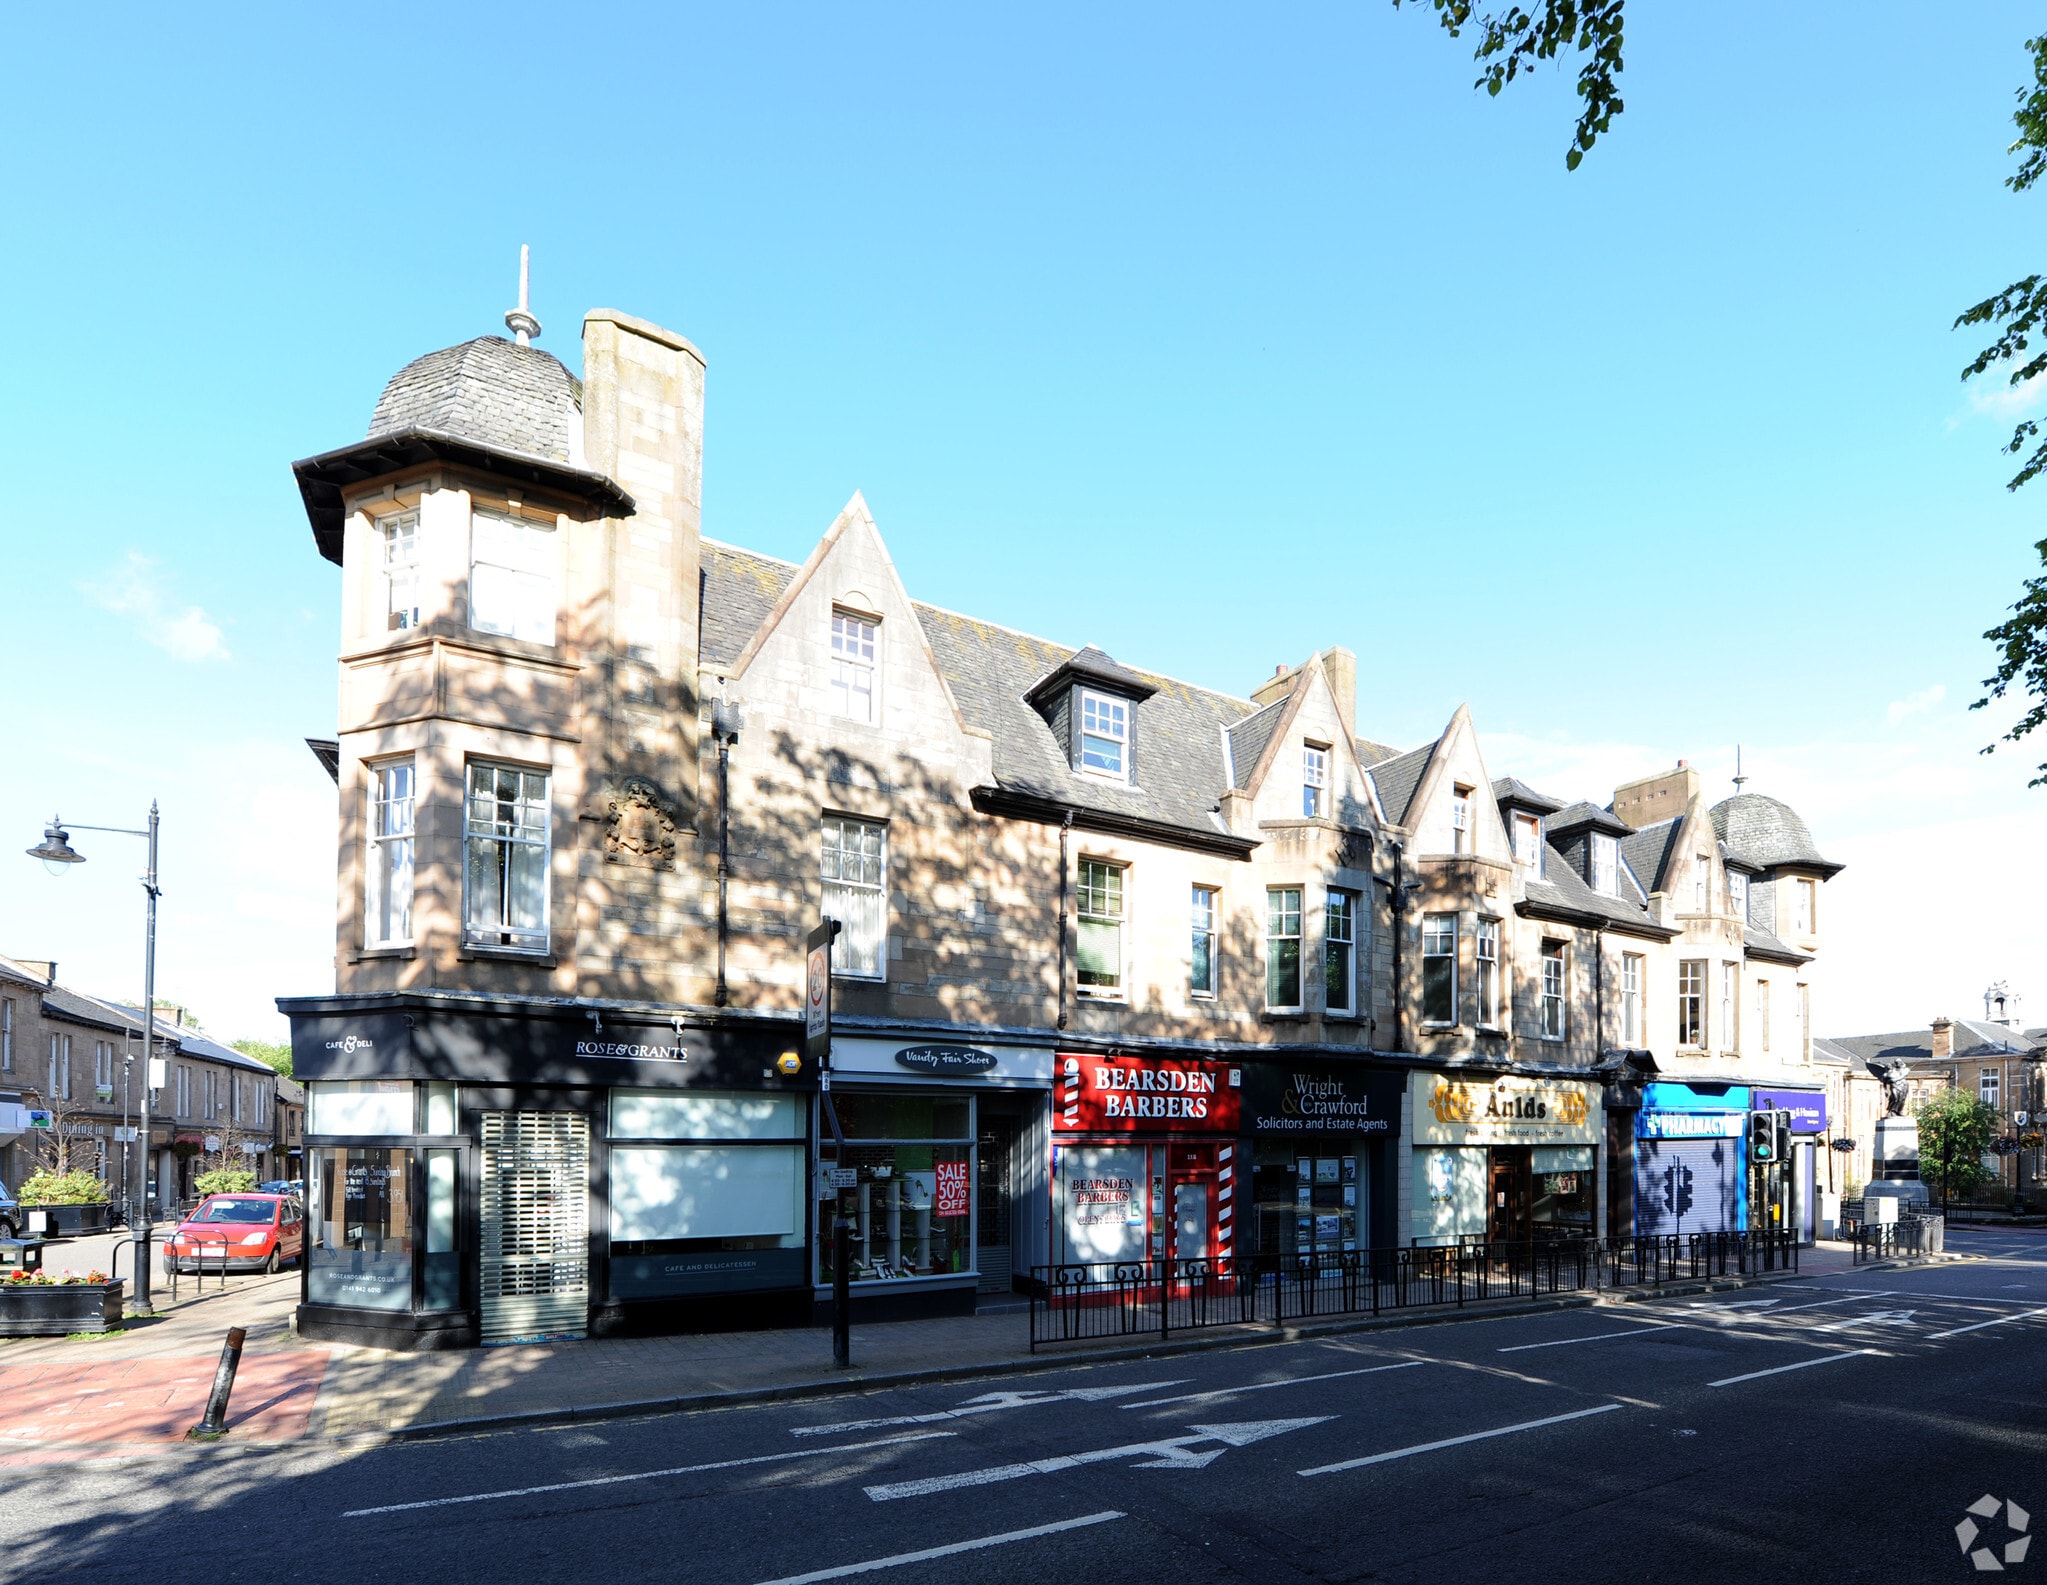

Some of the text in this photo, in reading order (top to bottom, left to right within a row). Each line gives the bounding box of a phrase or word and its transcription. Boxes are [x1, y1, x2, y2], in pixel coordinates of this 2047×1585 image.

[325, 1041, 344, 1050] CAFE
[356, 1040, 373, 1048] DELI
[940, 1052, 961, 1064] Fair
[963, 1053, 990, 1065] Shoes
[1094, 1067, 1217, 1094] BEARSDEN
[1292, 1073, 1344, 1099] Wright
[1104, 1095, 1208, 1119] BARBERS
[1281, 1089, 1368, 1115] & Crawford
[1484, 1092, 1546, 1120] Aulds
[1256, 1116, 1388, 1132] Solicitors and Estate Agents
[1661, 1116, 1725, 1136] PHARMACY
[1517, 1129, 1530, 1137] food
[1535, 1129, 1564, 1137] fresh coffee
[937, 1163, 967, 1181] SALE
[938, 1180, 967, 1200] 50%
[1071, 1178, 1134, 1191] BEARSDEN
[938, 1199, 966, 1211] OFF
[1076, 1191, 1130, 1204] BARBERS
[704, 1261, 757, 1270] DELICATESSEN
